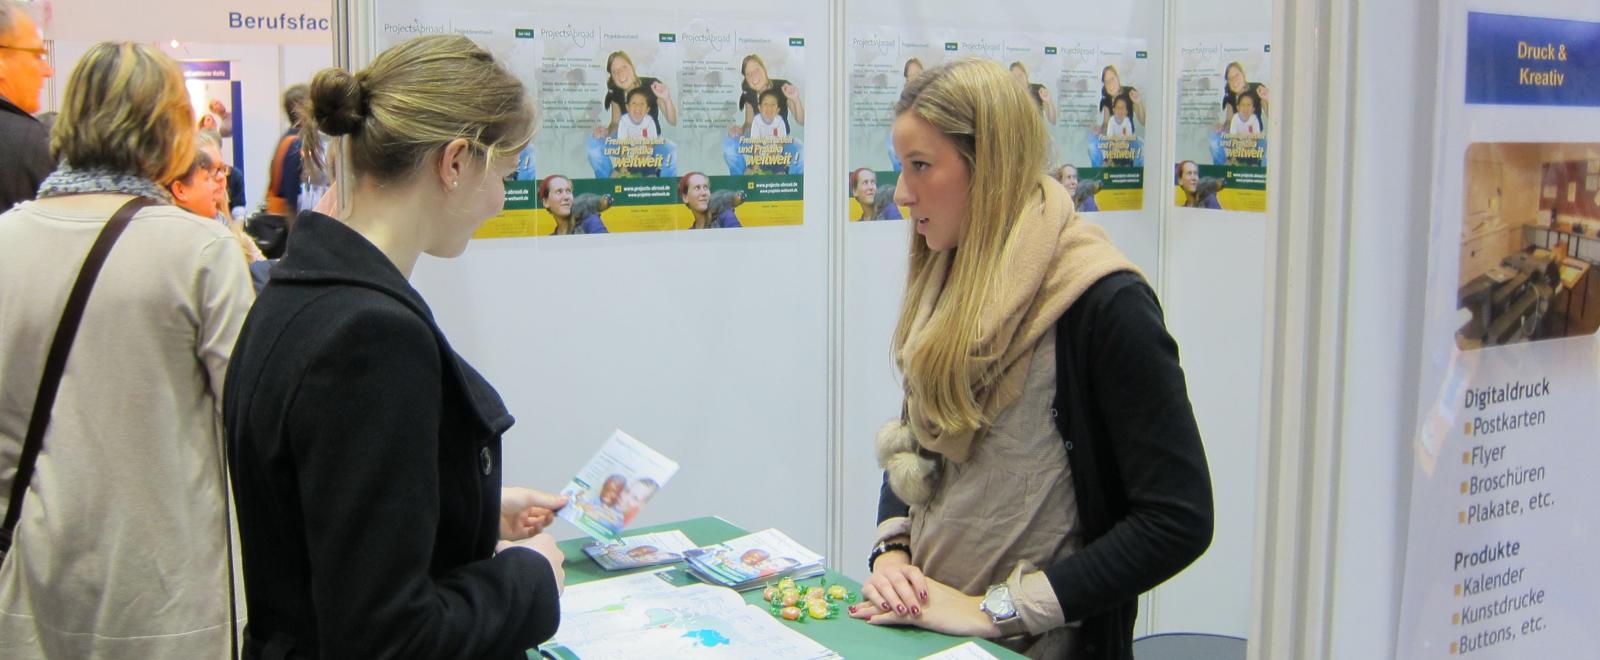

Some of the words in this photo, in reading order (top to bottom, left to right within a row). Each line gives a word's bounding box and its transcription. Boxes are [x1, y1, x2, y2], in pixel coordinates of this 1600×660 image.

[228, 11, 329, 31] Berufsfac
[1518, 41, 1555, 60] Druck
[1558, 43, 1567, 60] &
[1520, 67, 1564, 86] Kreativ
[611, 153, 663, 168] weltweit
[745, 152, 791, 166] weltweit
[1465, 378, 1550, 411] Digitaldruck
[1473, 409, 1545, 436] Postkarten
[1471, 445, 1506, 468] Flyer
[1470, 466, 1545, 495] Broschüren
[1468, 499, 1524, 525] Plakate,
[1529, 491, 1554, 510] etc.
[1454, 541, 1520, 572] Produkte
[1463, 566, 1525, 597] Kalender
[1461, 588, 1545, 625] Kunstdrucke
[1459, 626, 1516, 655] Buttons,
[1521, 616, 1547, 636] etc.
